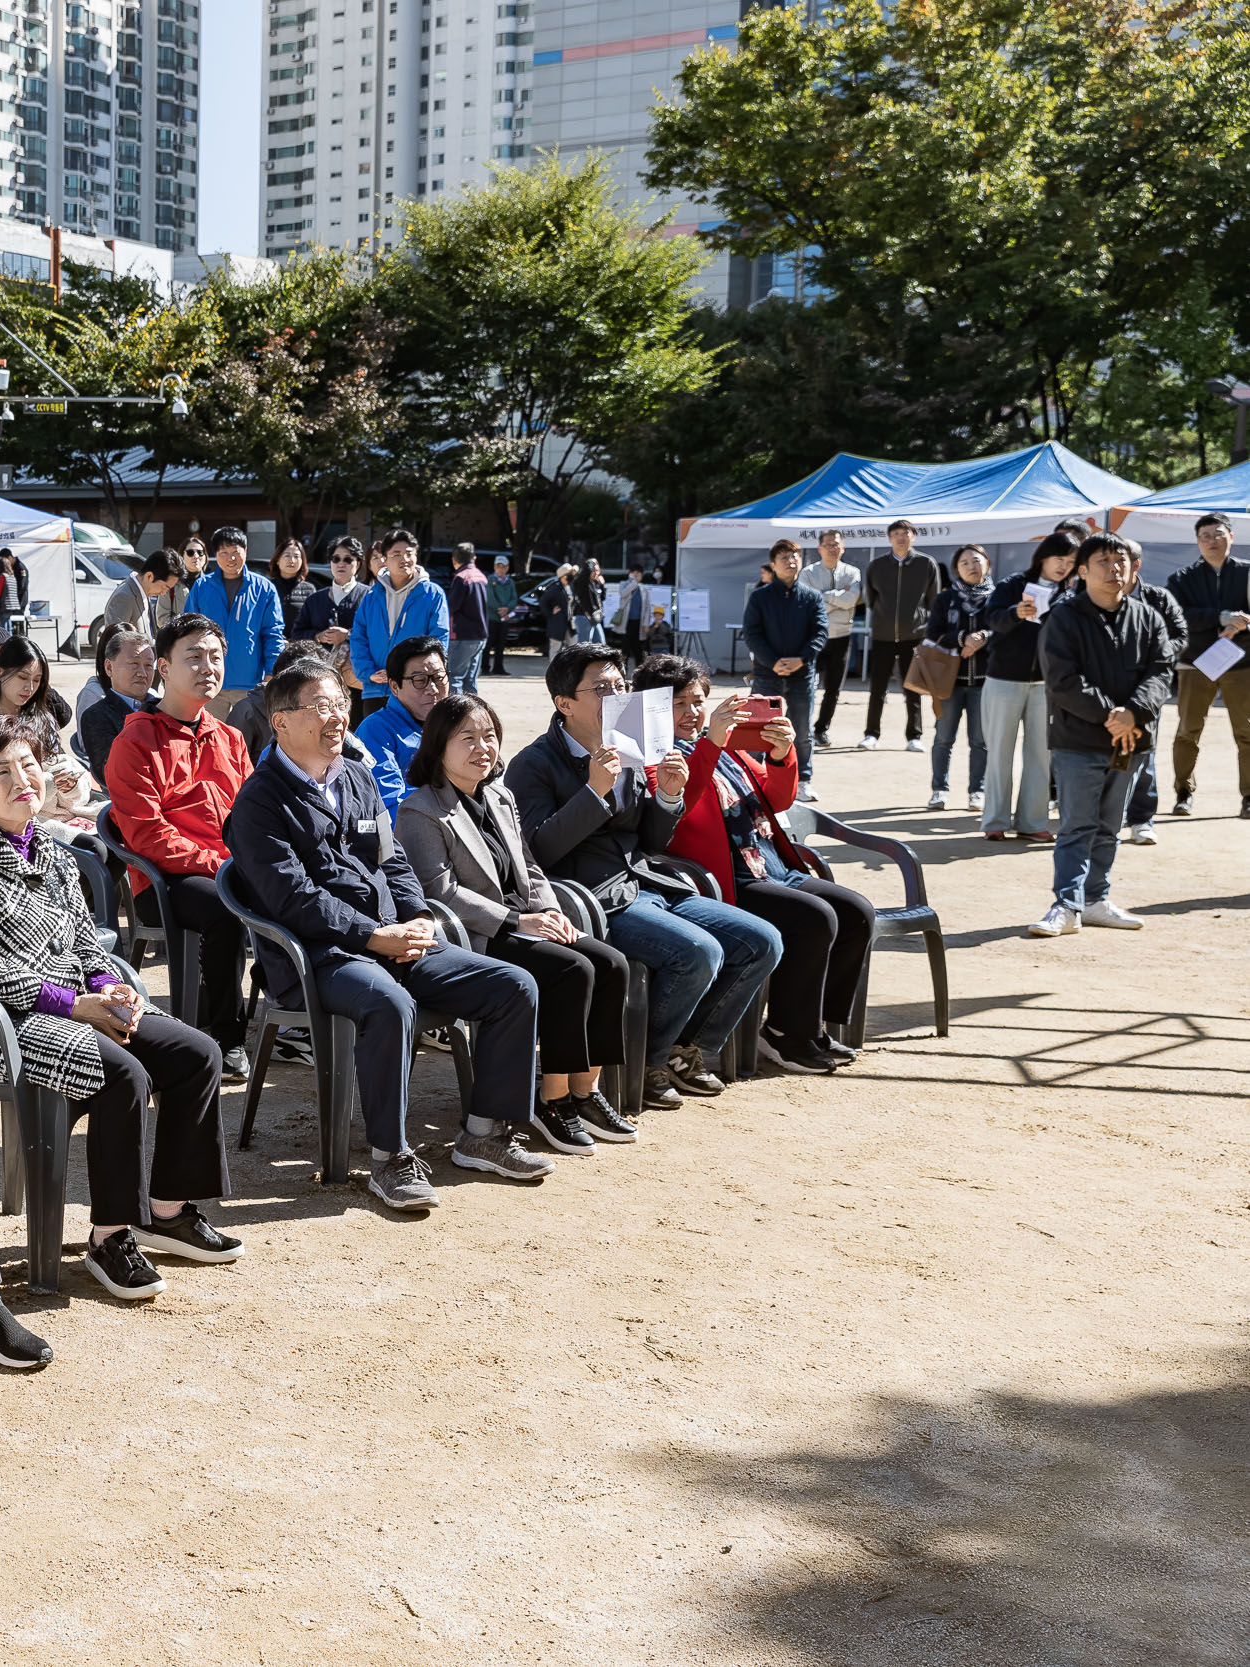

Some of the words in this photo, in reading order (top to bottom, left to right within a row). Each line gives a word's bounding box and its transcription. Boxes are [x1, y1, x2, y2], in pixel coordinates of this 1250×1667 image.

[36, 403, 50, 412] CCTV
[800, 529, 817, 540] 세계
[857, 527, 886, 538] 맛있는
